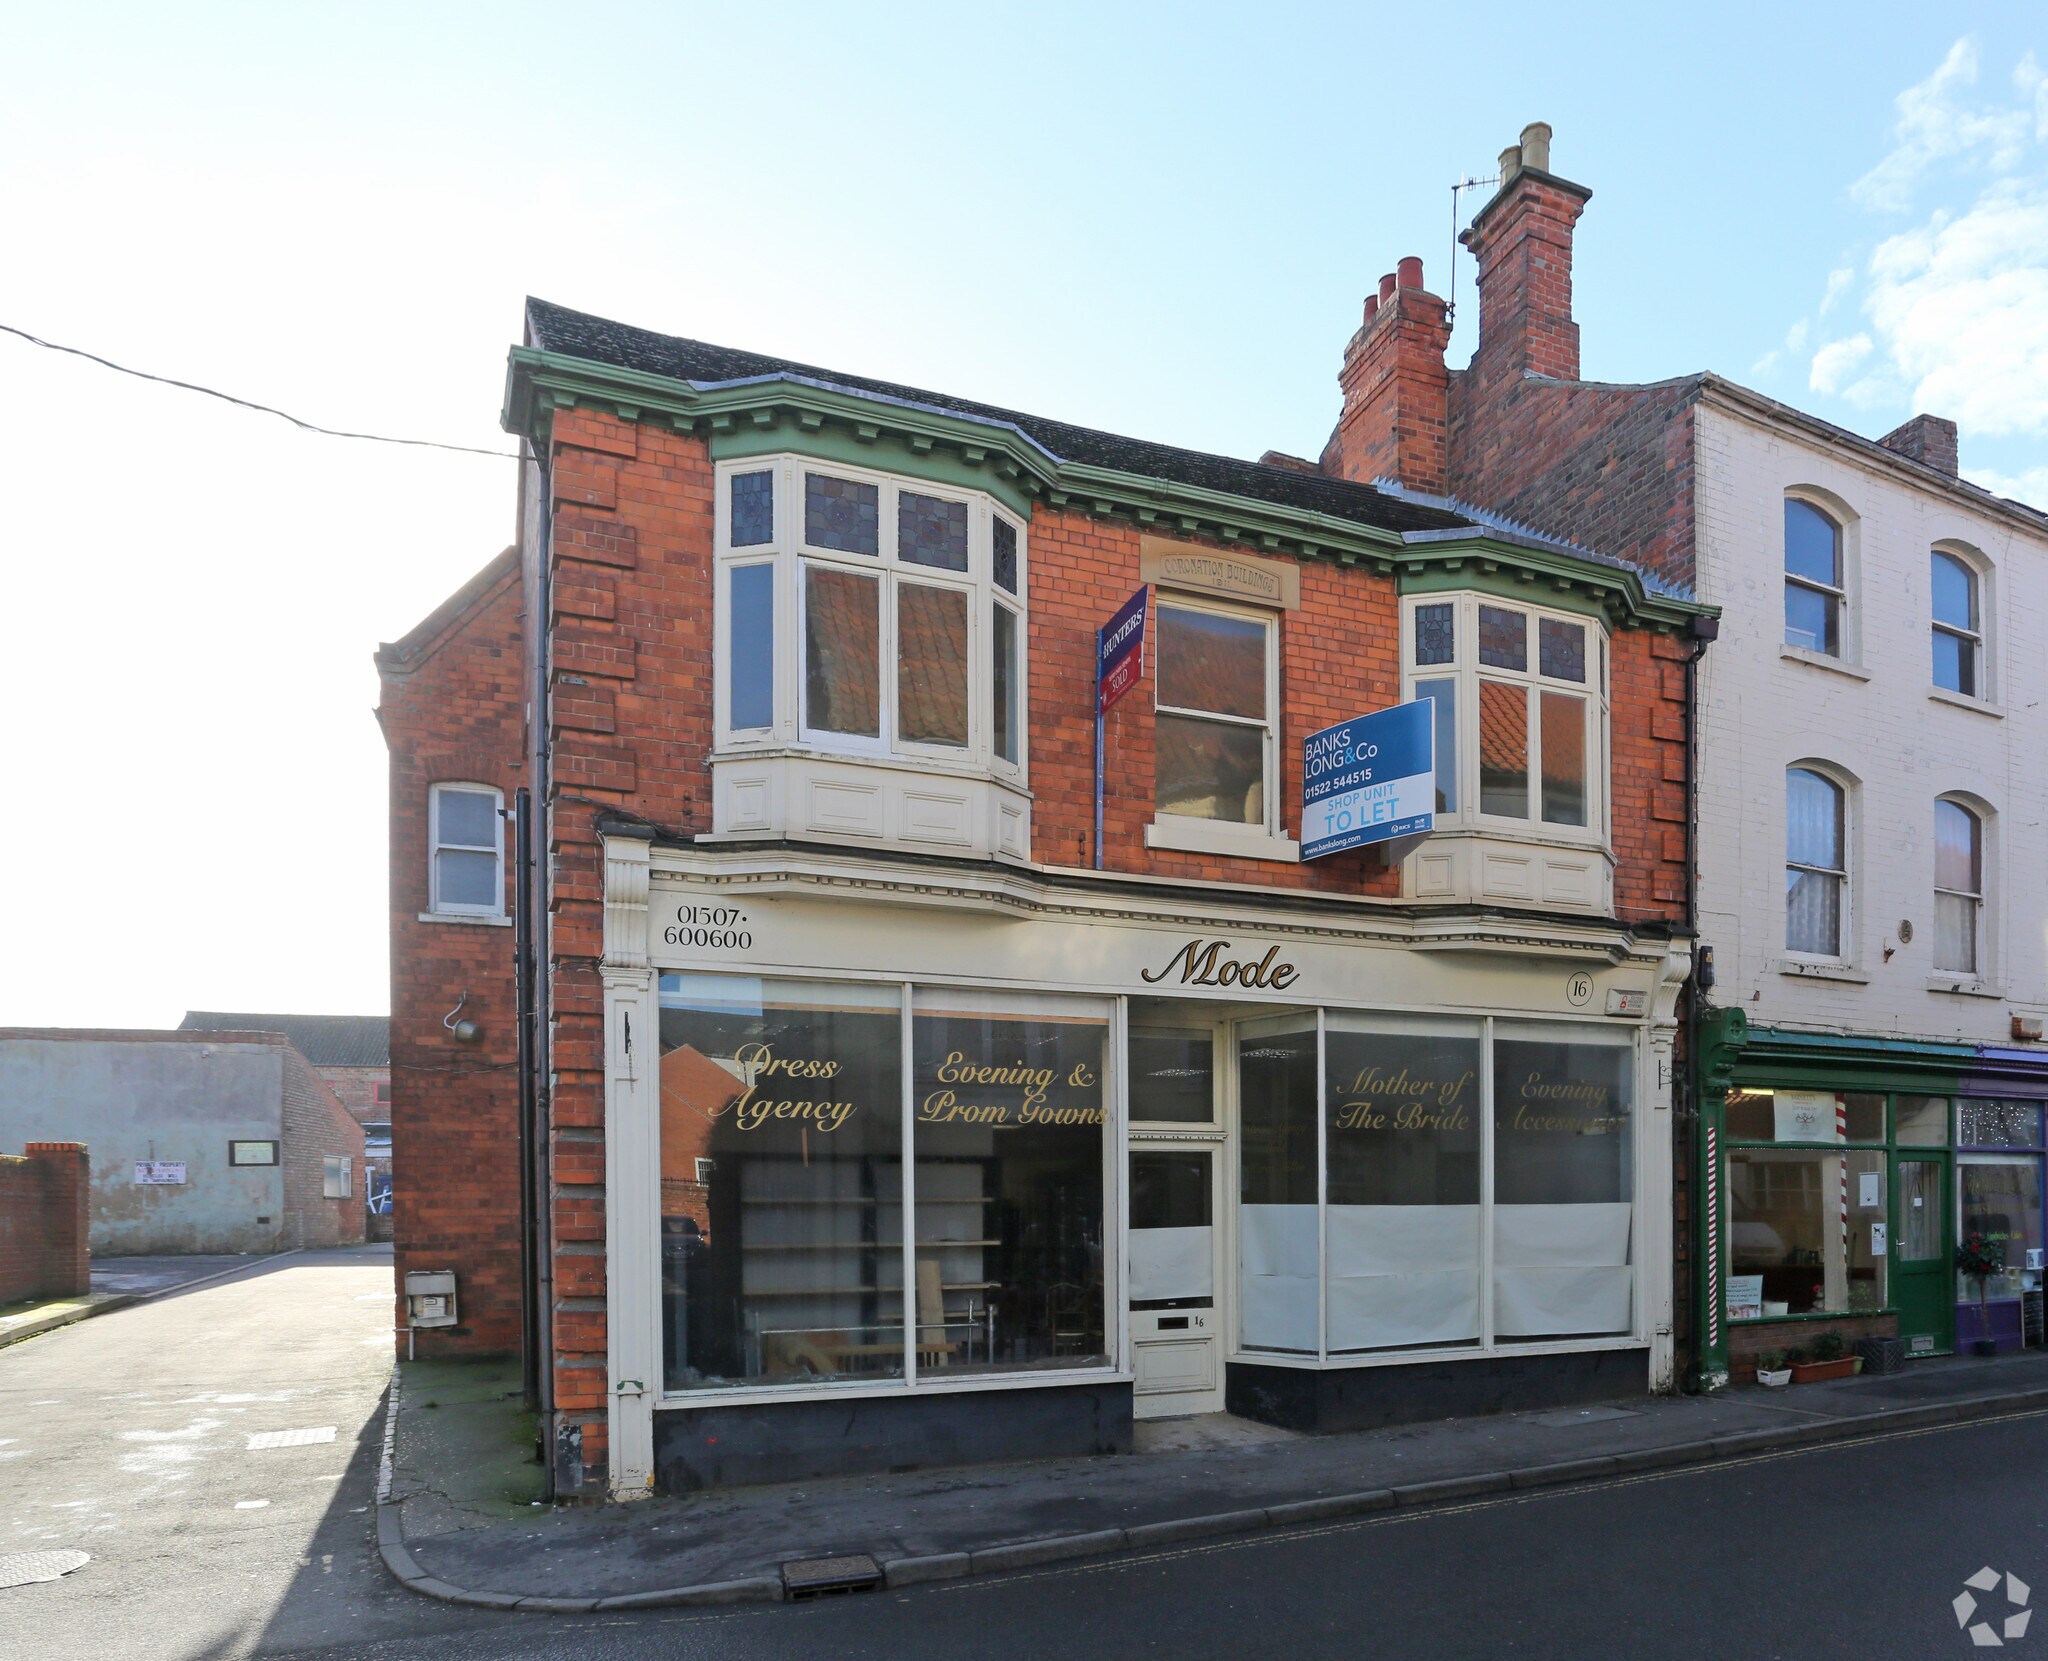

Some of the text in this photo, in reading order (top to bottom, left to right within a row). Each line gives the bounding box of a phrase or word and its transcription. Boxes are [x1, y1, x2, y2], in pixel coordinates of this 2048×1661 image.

[1164, 558, 1274, 592] CORONATION BUILDINGS
[1103, 606, 1144, 660] HUNTERS
[1112, 668, 1128, 693] SOLD
[1305, 728, 1351, 761] BANKS
[1305, 742, 1378, 780] LONG&Co
[1305, 768, 1372, 800] 01522 544515
[1328, 783, 1395, 812] SHOP UNIT
[1324, 811, 1352, 835] TO
[1360, 798, 1400, 826] LET
[1304, 834, 1361, 856] www.bankslong.com
[664, 926, 752, 949] 600600
[1141, 939, 1300, 990] Mode
[1573, 981, 1587, 997] 16
[734, 1042, 843, 1079] Dress
[937, 1051, 1096, 1098] Evening &
[1336, 1066, 1474, 1106] Mother of
[1521, 1071, 1608, 1109] Evening
[707, 1084, 857, 1132] Agency
[918, 1089, 1110, 1125] Prom Gowns
[1336, 1101, 1388, 1129] The
[1393, 1102, 1469, 1130] Bride
[1194, 1315, 1204, 1328] 16
